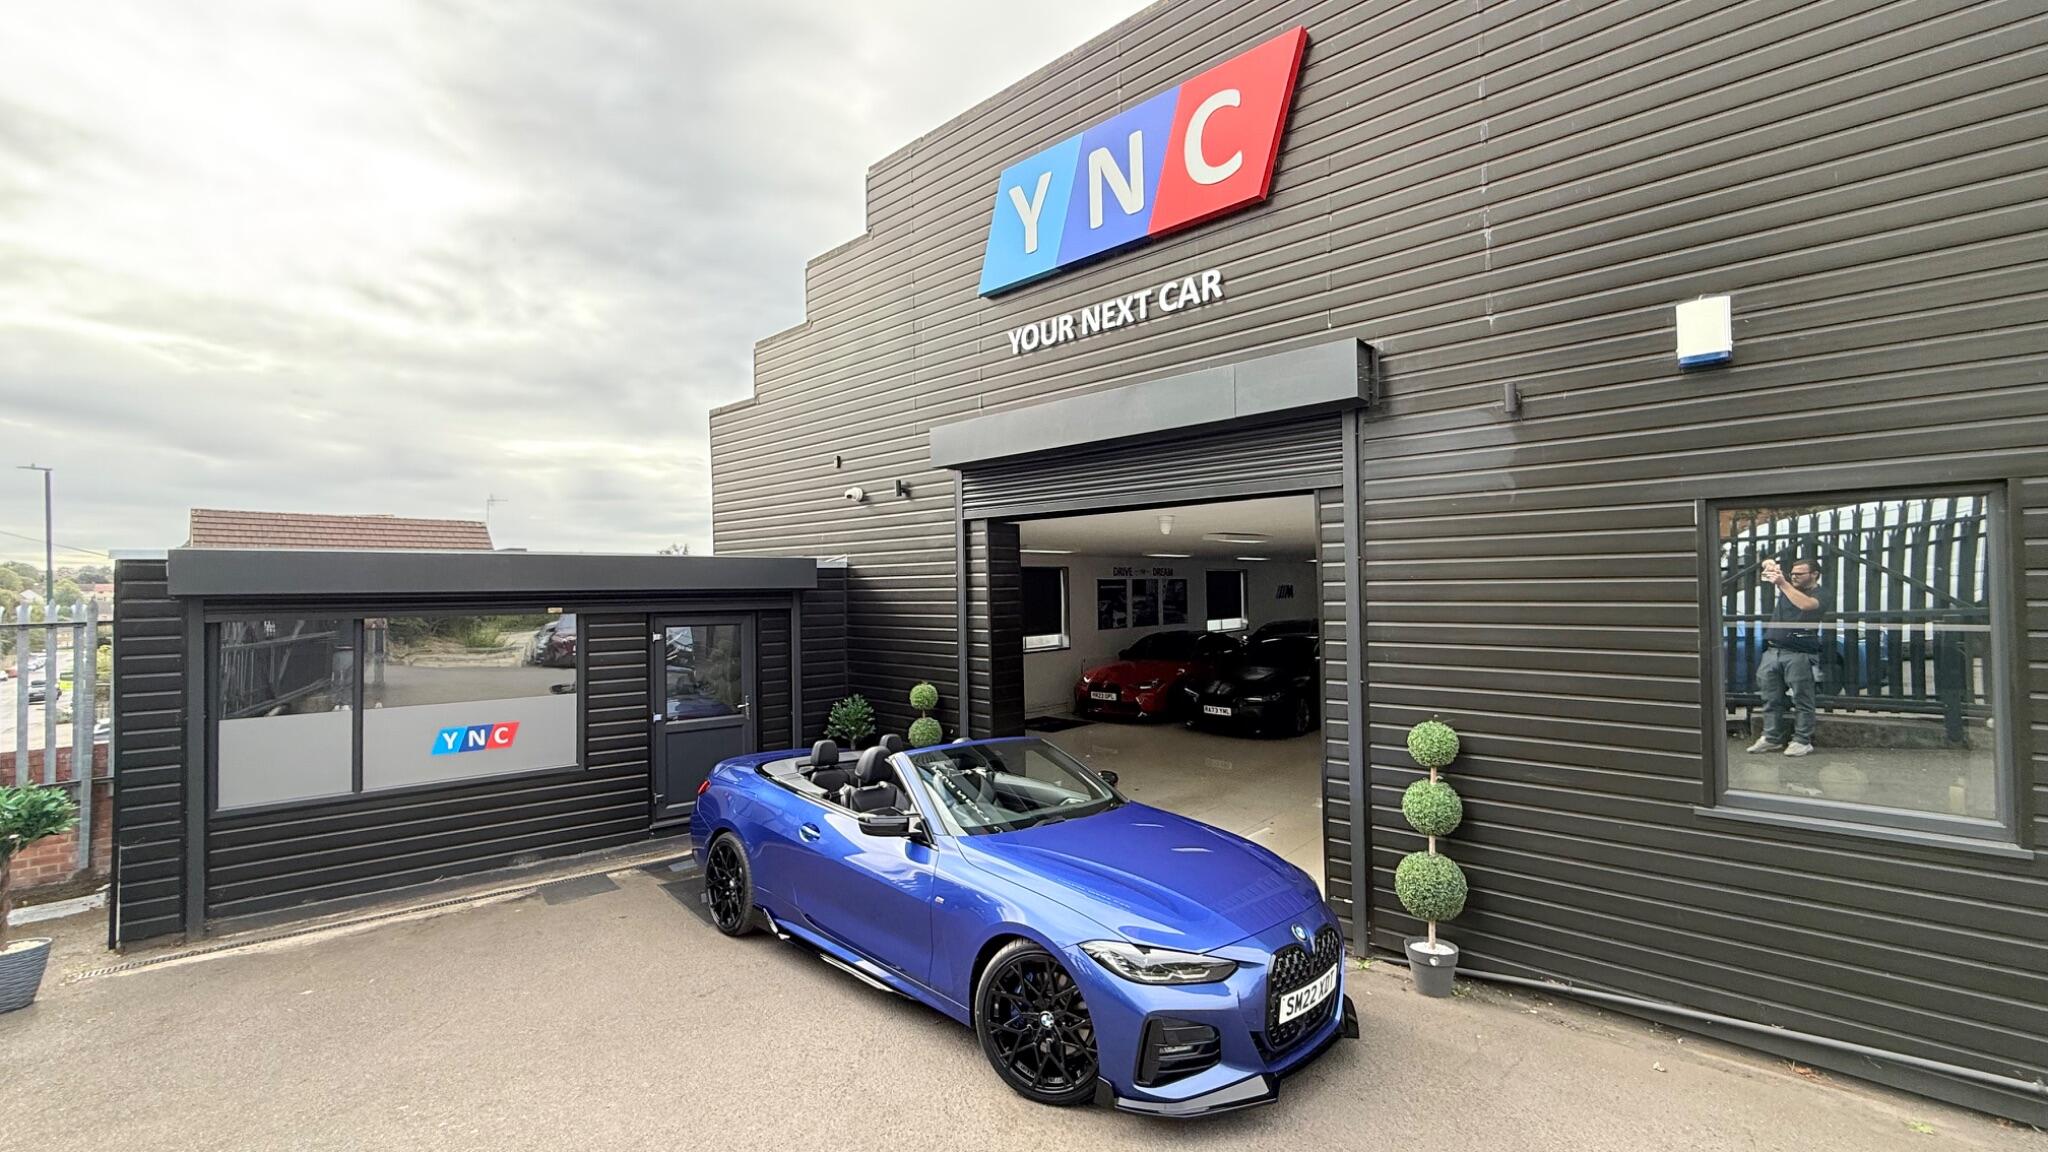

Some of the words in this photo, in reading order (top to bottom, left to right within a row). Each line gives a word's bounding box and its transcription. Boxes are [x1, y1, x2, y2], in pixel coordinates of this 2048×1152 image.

[1009, 89, 1243, 254] YNC
[1008, 313, 1075, 354] YOUR
[1081, 289, 1153, 335] NEXT
[1159, 269, 1224, 313] CAR
[1113, 567, 1133, 577] DRIVE
[1152, 567, 1173, 577] DREAM
[442, 726, 509, 750] YNC
[1286, 985, 1317, 1016] SM22
[1319, 970, 1335, 999] XDT
